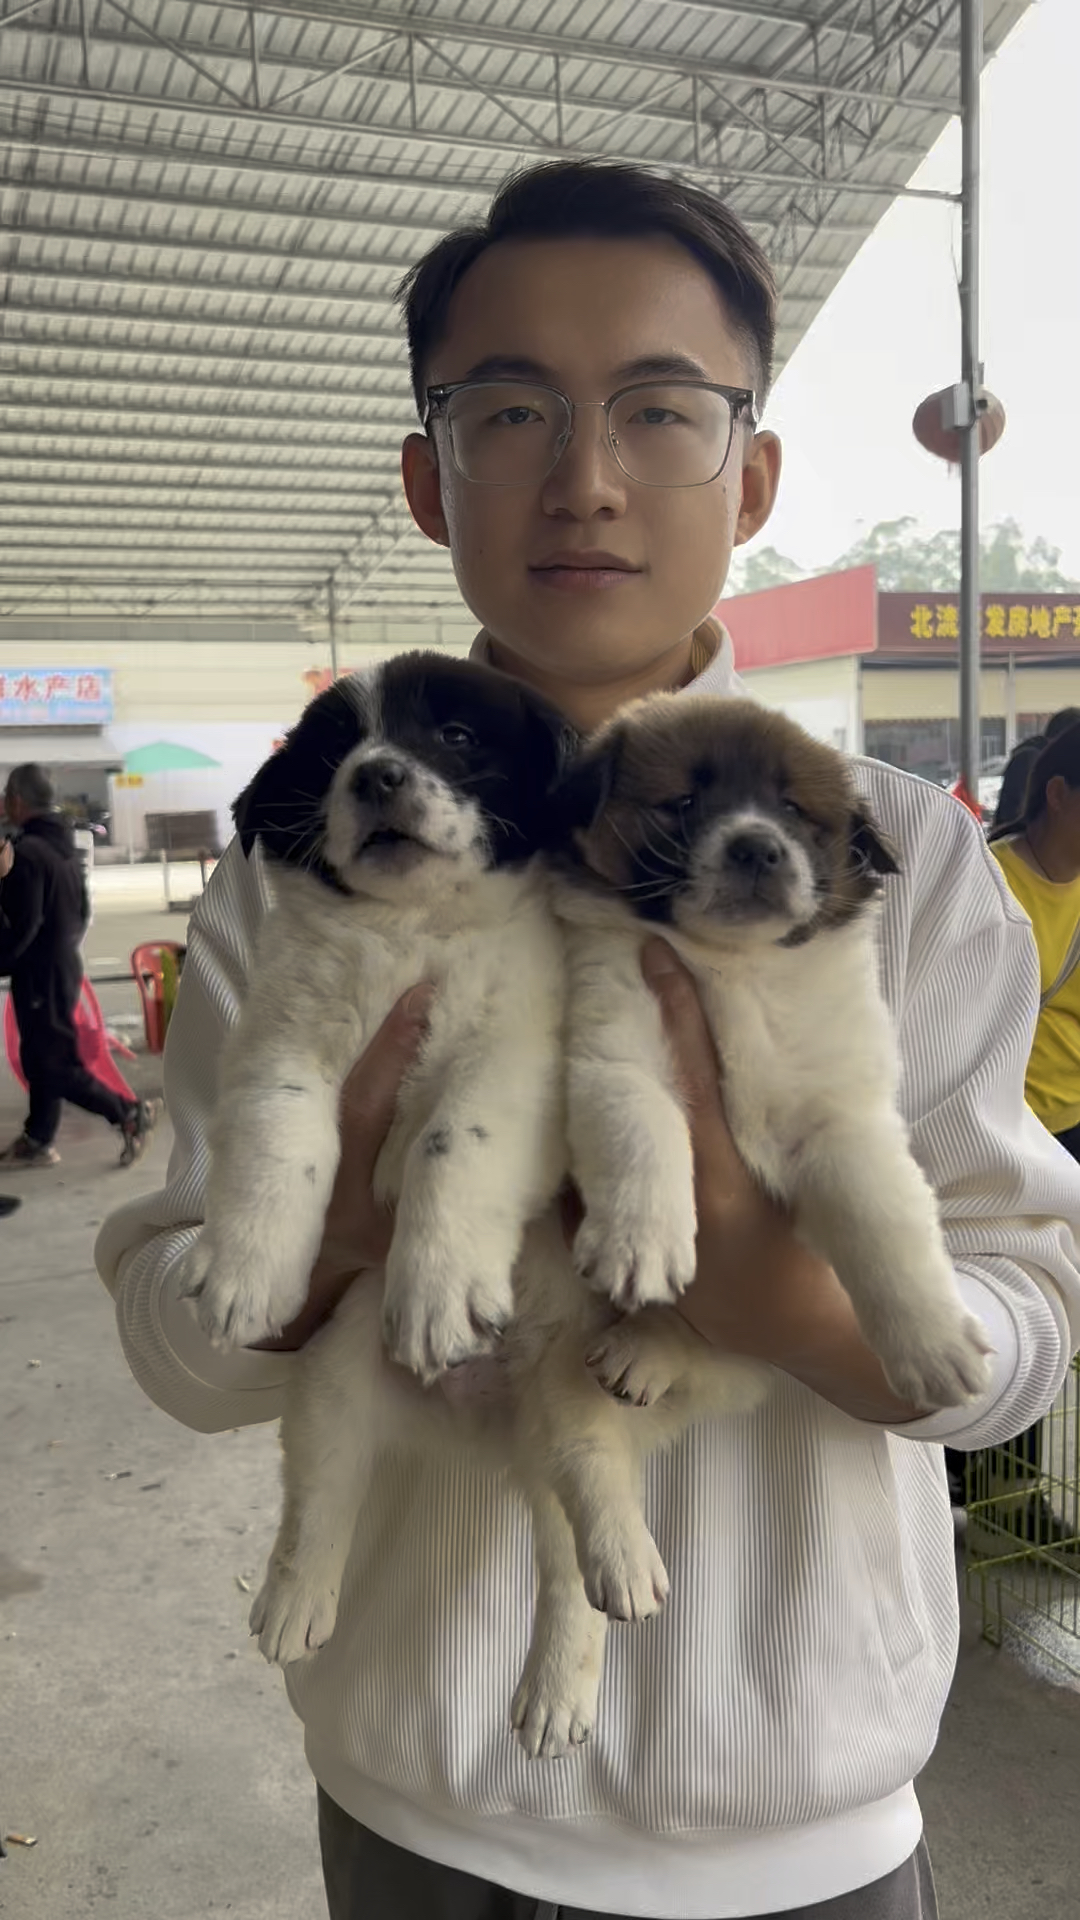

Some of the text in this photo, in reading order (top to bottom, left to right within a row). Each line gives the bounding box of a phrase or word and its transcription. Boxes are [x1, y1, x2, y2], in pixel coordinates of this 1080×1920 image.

[911, 604, 1080, 638] 北流发房地产
[0, 673, 102, 702] 水产店
